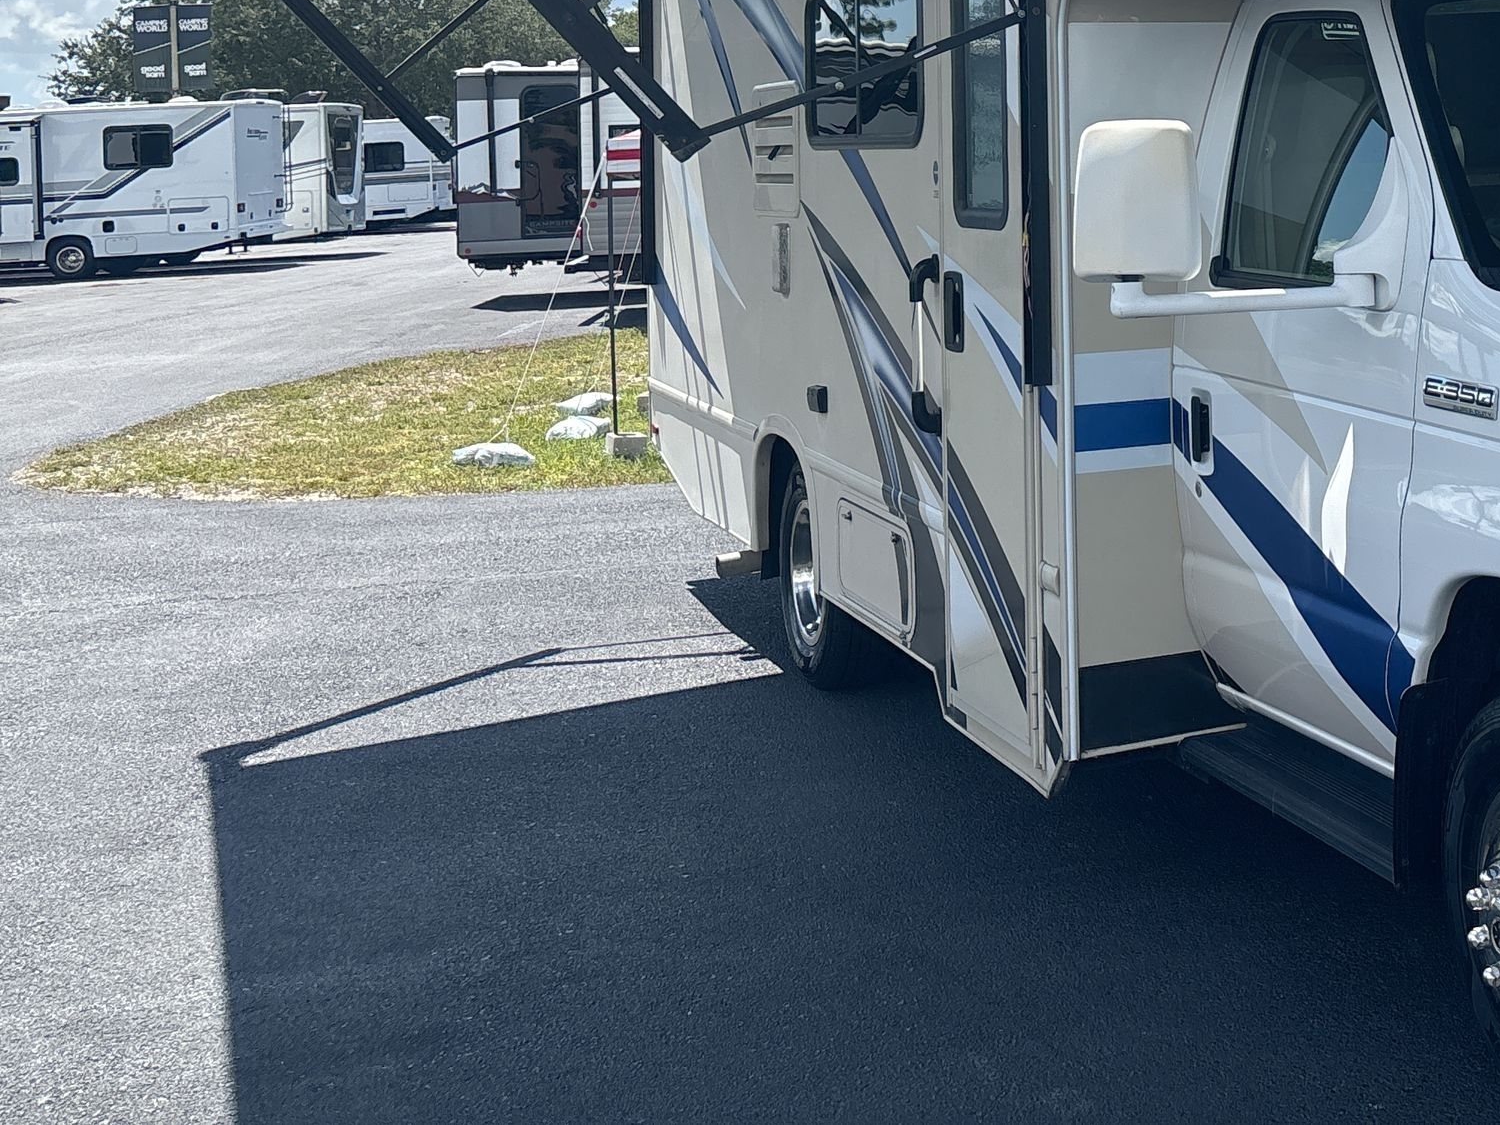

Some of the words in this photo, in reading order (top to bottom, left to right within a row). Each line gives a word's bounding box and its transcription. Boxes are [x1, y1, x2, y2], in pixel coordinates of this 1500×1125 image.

[136, 24, 168, 33] WORLD
[179, 22, 208, 31] WORLD
[140, 64, 165, 75] good
[184, 62, 206, 73] good
